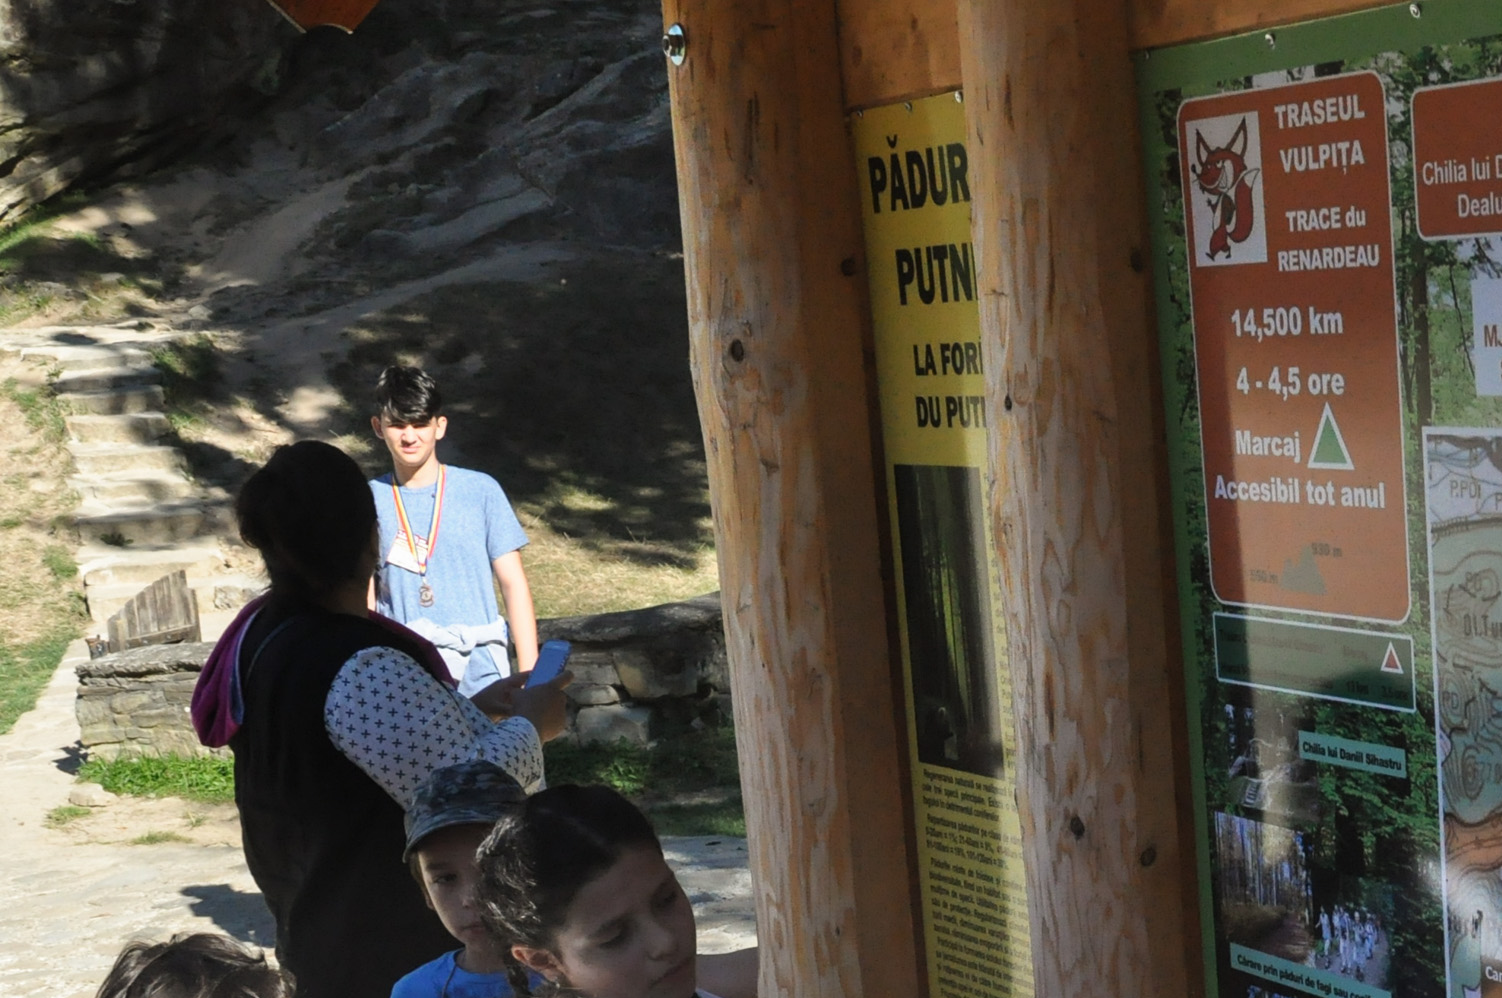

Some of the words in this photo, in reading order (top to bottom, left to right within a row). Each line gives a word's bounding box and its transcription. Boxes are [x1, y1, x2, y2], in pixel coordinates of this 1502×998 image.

[1273, 94, 1366, 130] TRASEUL
[1279, 139, 1365, 177] VULPIȚA
[1422, 157, 1467, 187] Chilia
[1470, 153, 1492, 183] lui
[1286, 208, 1341, 233] TRACE
[1345, 206, 1367, 229] du
[1277, 244, 1381, 272] RENARDEAU
[1230, 307, 1302, 340] 14,500
[1309, 306, 1344, 336] km
[913, 344, 937, 376] LA
[940, 336, 984, 376] FOR
[1236, 369, 1249, 396] 4
[1269, 369, 1301, 398] 4,5
[1307, 373, 1345, 397] ore
[915, 396, 942, 428] DU
[1235, 430, 1301, 464] Marcaj
[1214, 474, 1300, 505] Accesibil
[1305, 482, 1335, 507] tot
[1340, 480, 1386, 509] anul
